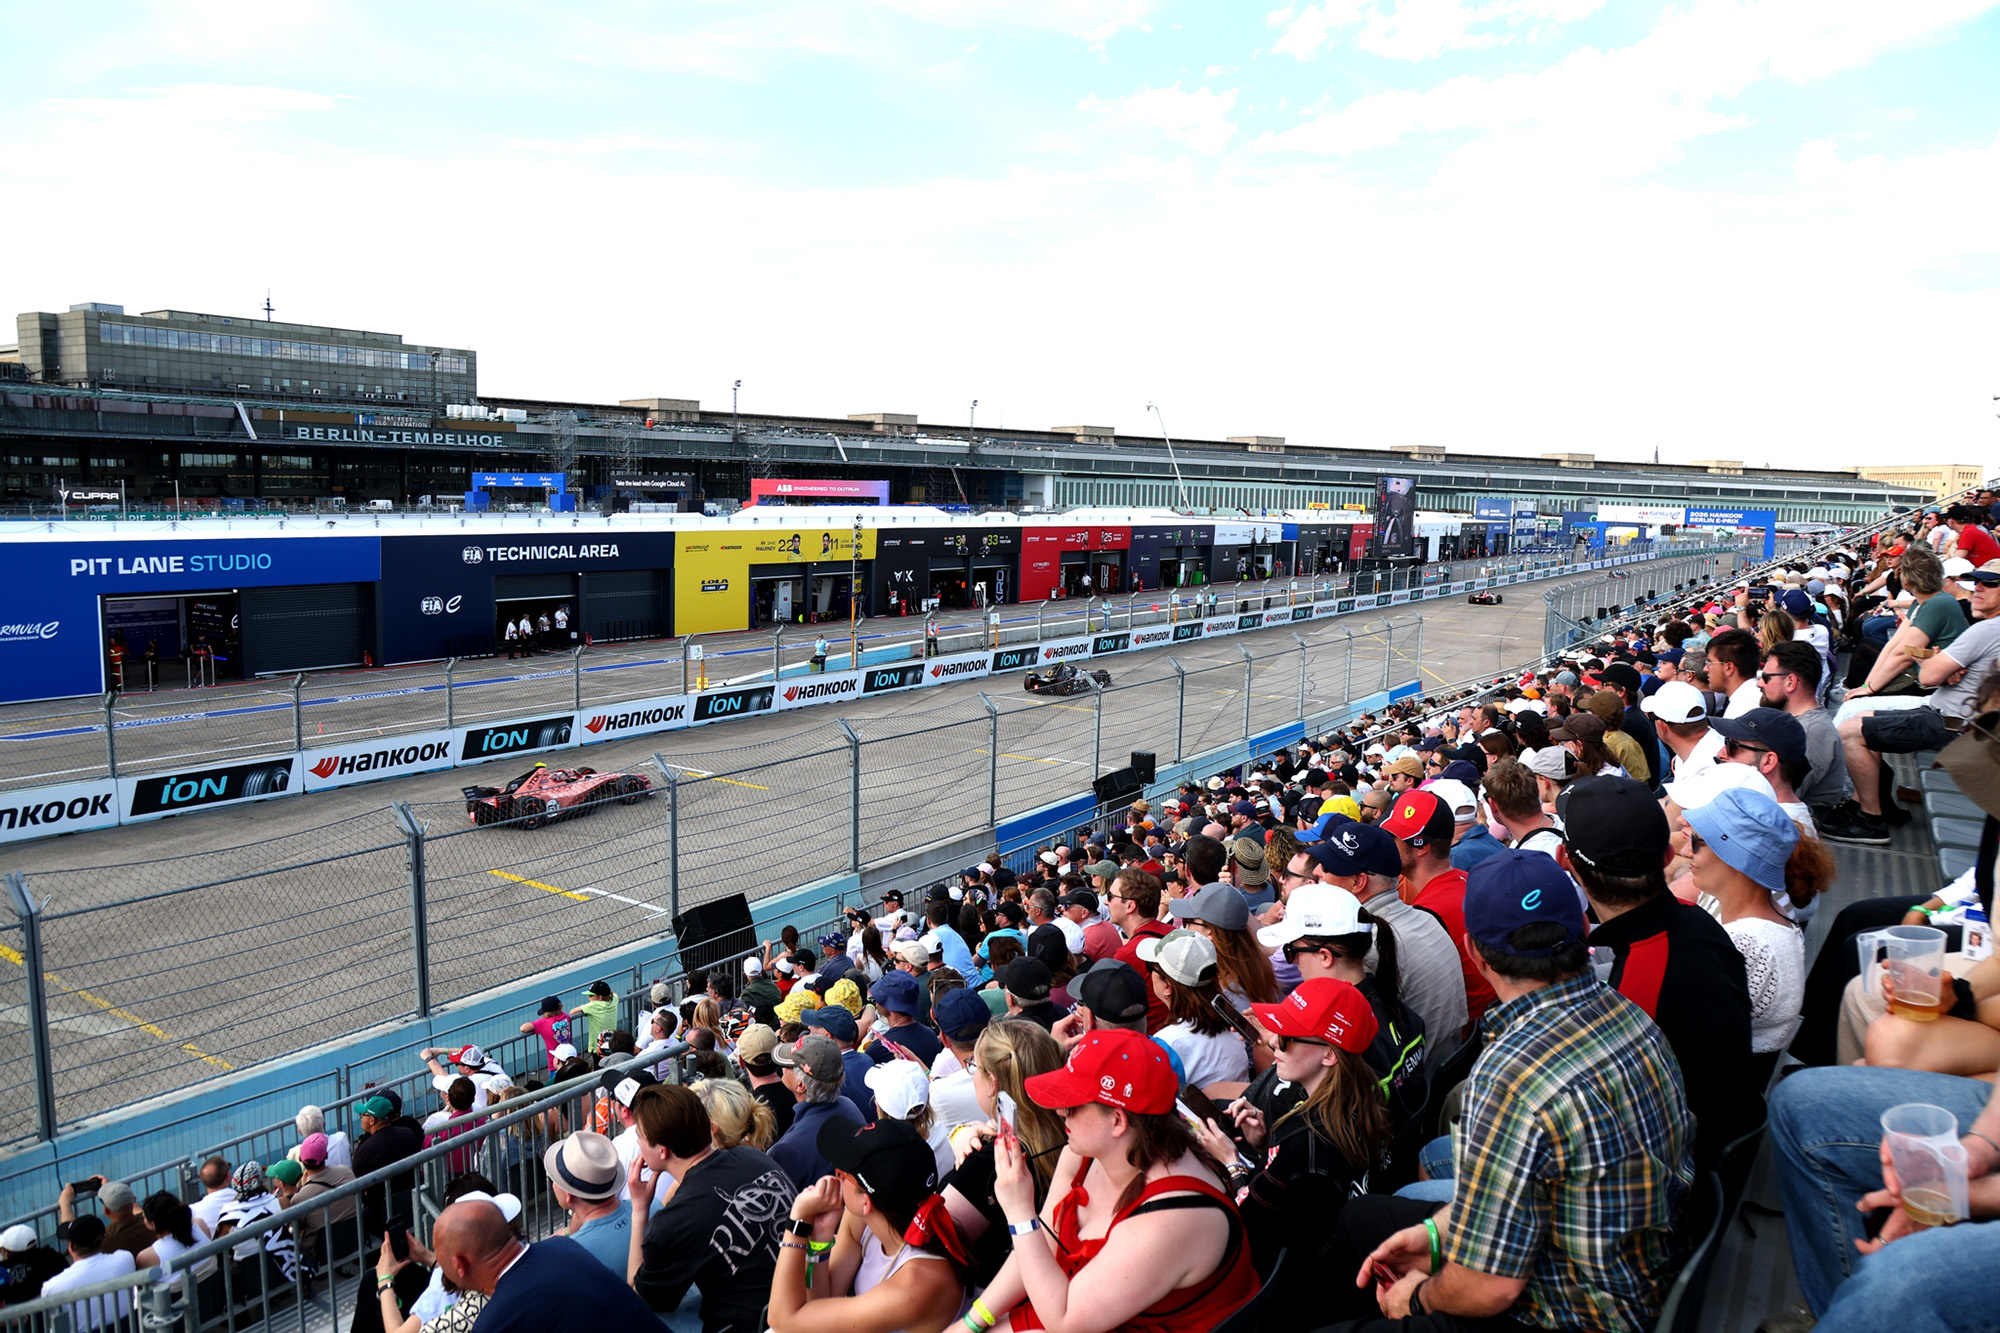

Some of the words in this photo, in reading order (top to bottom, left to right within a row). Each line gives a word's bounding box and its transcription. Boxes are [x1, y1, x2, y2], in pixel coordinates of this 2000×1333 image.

[651, 480, 666, 488] Google
[776, 484, 792, 492] ABB
[72, 492, 119, 500] CUPRA
[987, 535, 998, 546] 33
[1076, 533, 1085, 543] 37
[1104, 533, 1112, 542] 25
[778, 539, 794, 552] 22
[830, 538, 839, 550] 11
[486, 544, 577, 562] TECHNICAL
[579, 544, 620, 558] AREA
[70, 558, 112, 576] PIT
[118, 556, 184, 575] LANE
[190, 553, 272, 572] STUDIO
[996, 570, 1004, 604] KIRO
[531, 772, 542, 786] TDK
[1328, 1023, 1344, 1036] 21
